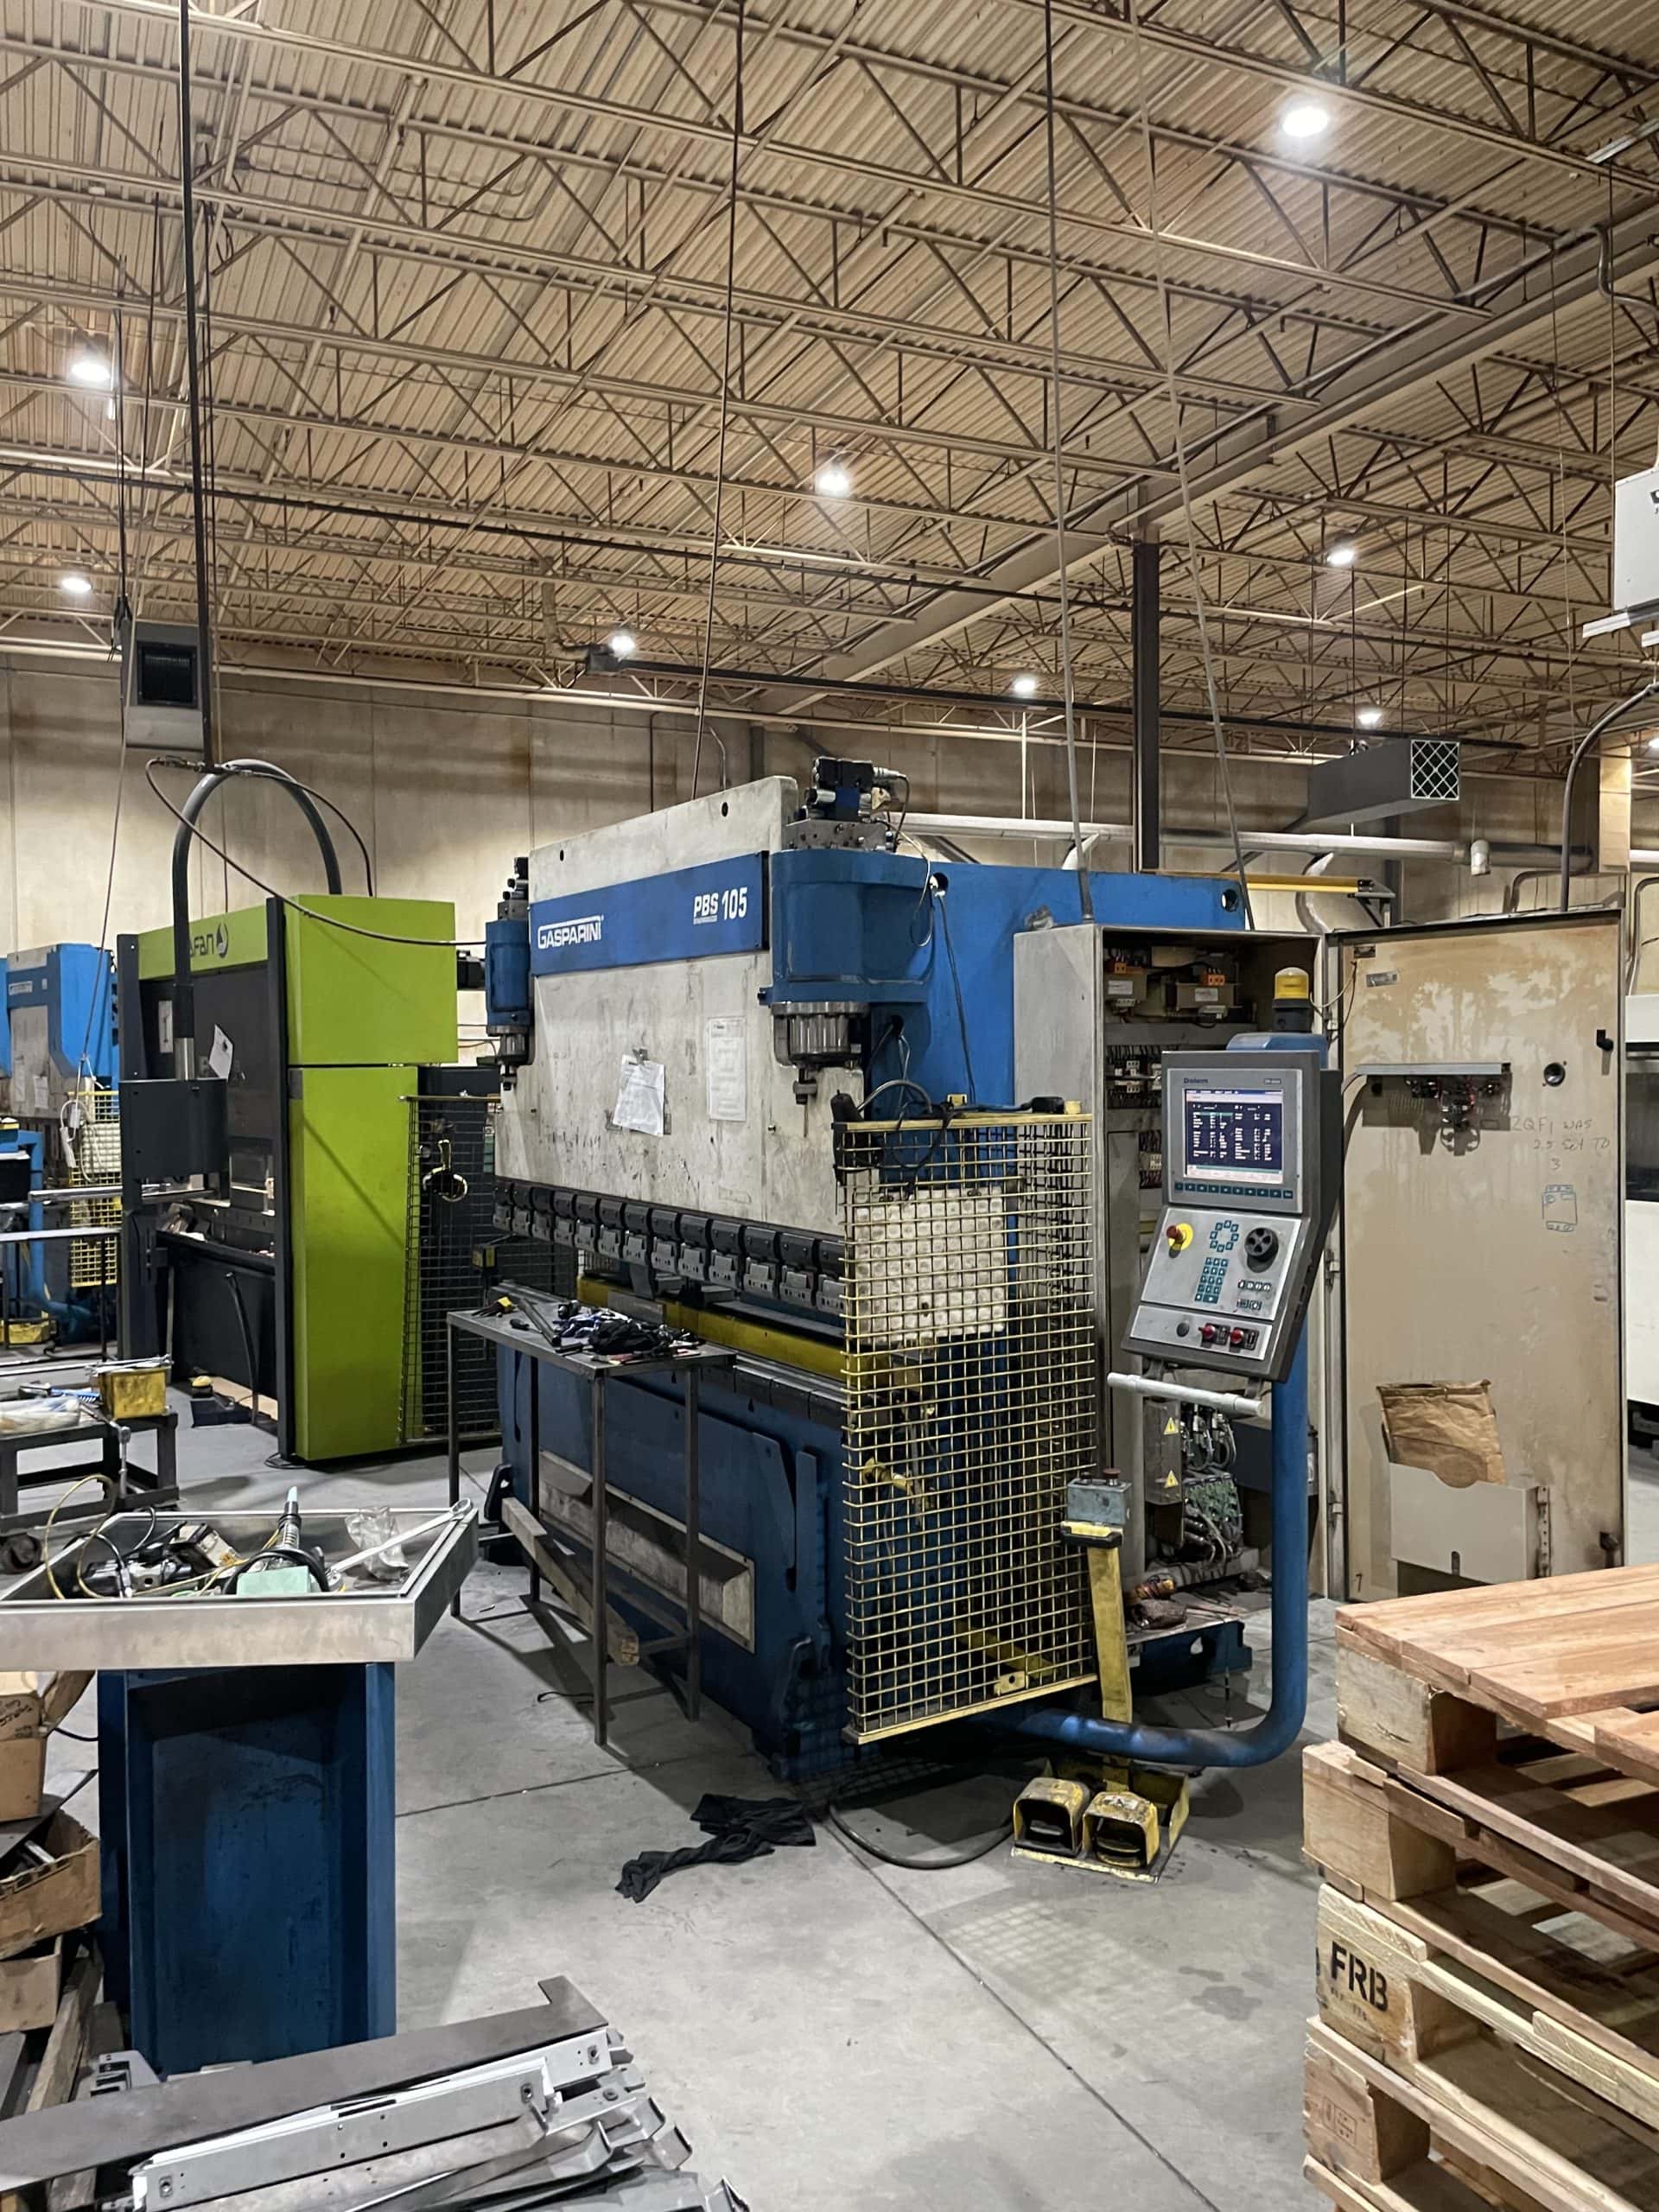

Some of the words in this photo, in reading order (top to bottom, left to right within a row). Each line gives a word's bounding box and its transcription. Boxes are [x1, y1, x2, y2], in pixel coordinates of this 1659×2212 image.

[694, 893, 719, 918] PBS
[721, 887, 747, 920] 105
[537, 916, 602, 950] GASPARINI
[1551, 1158, 1560, 1171] 3
[1331, 1940, 1389, 2012] FRB
